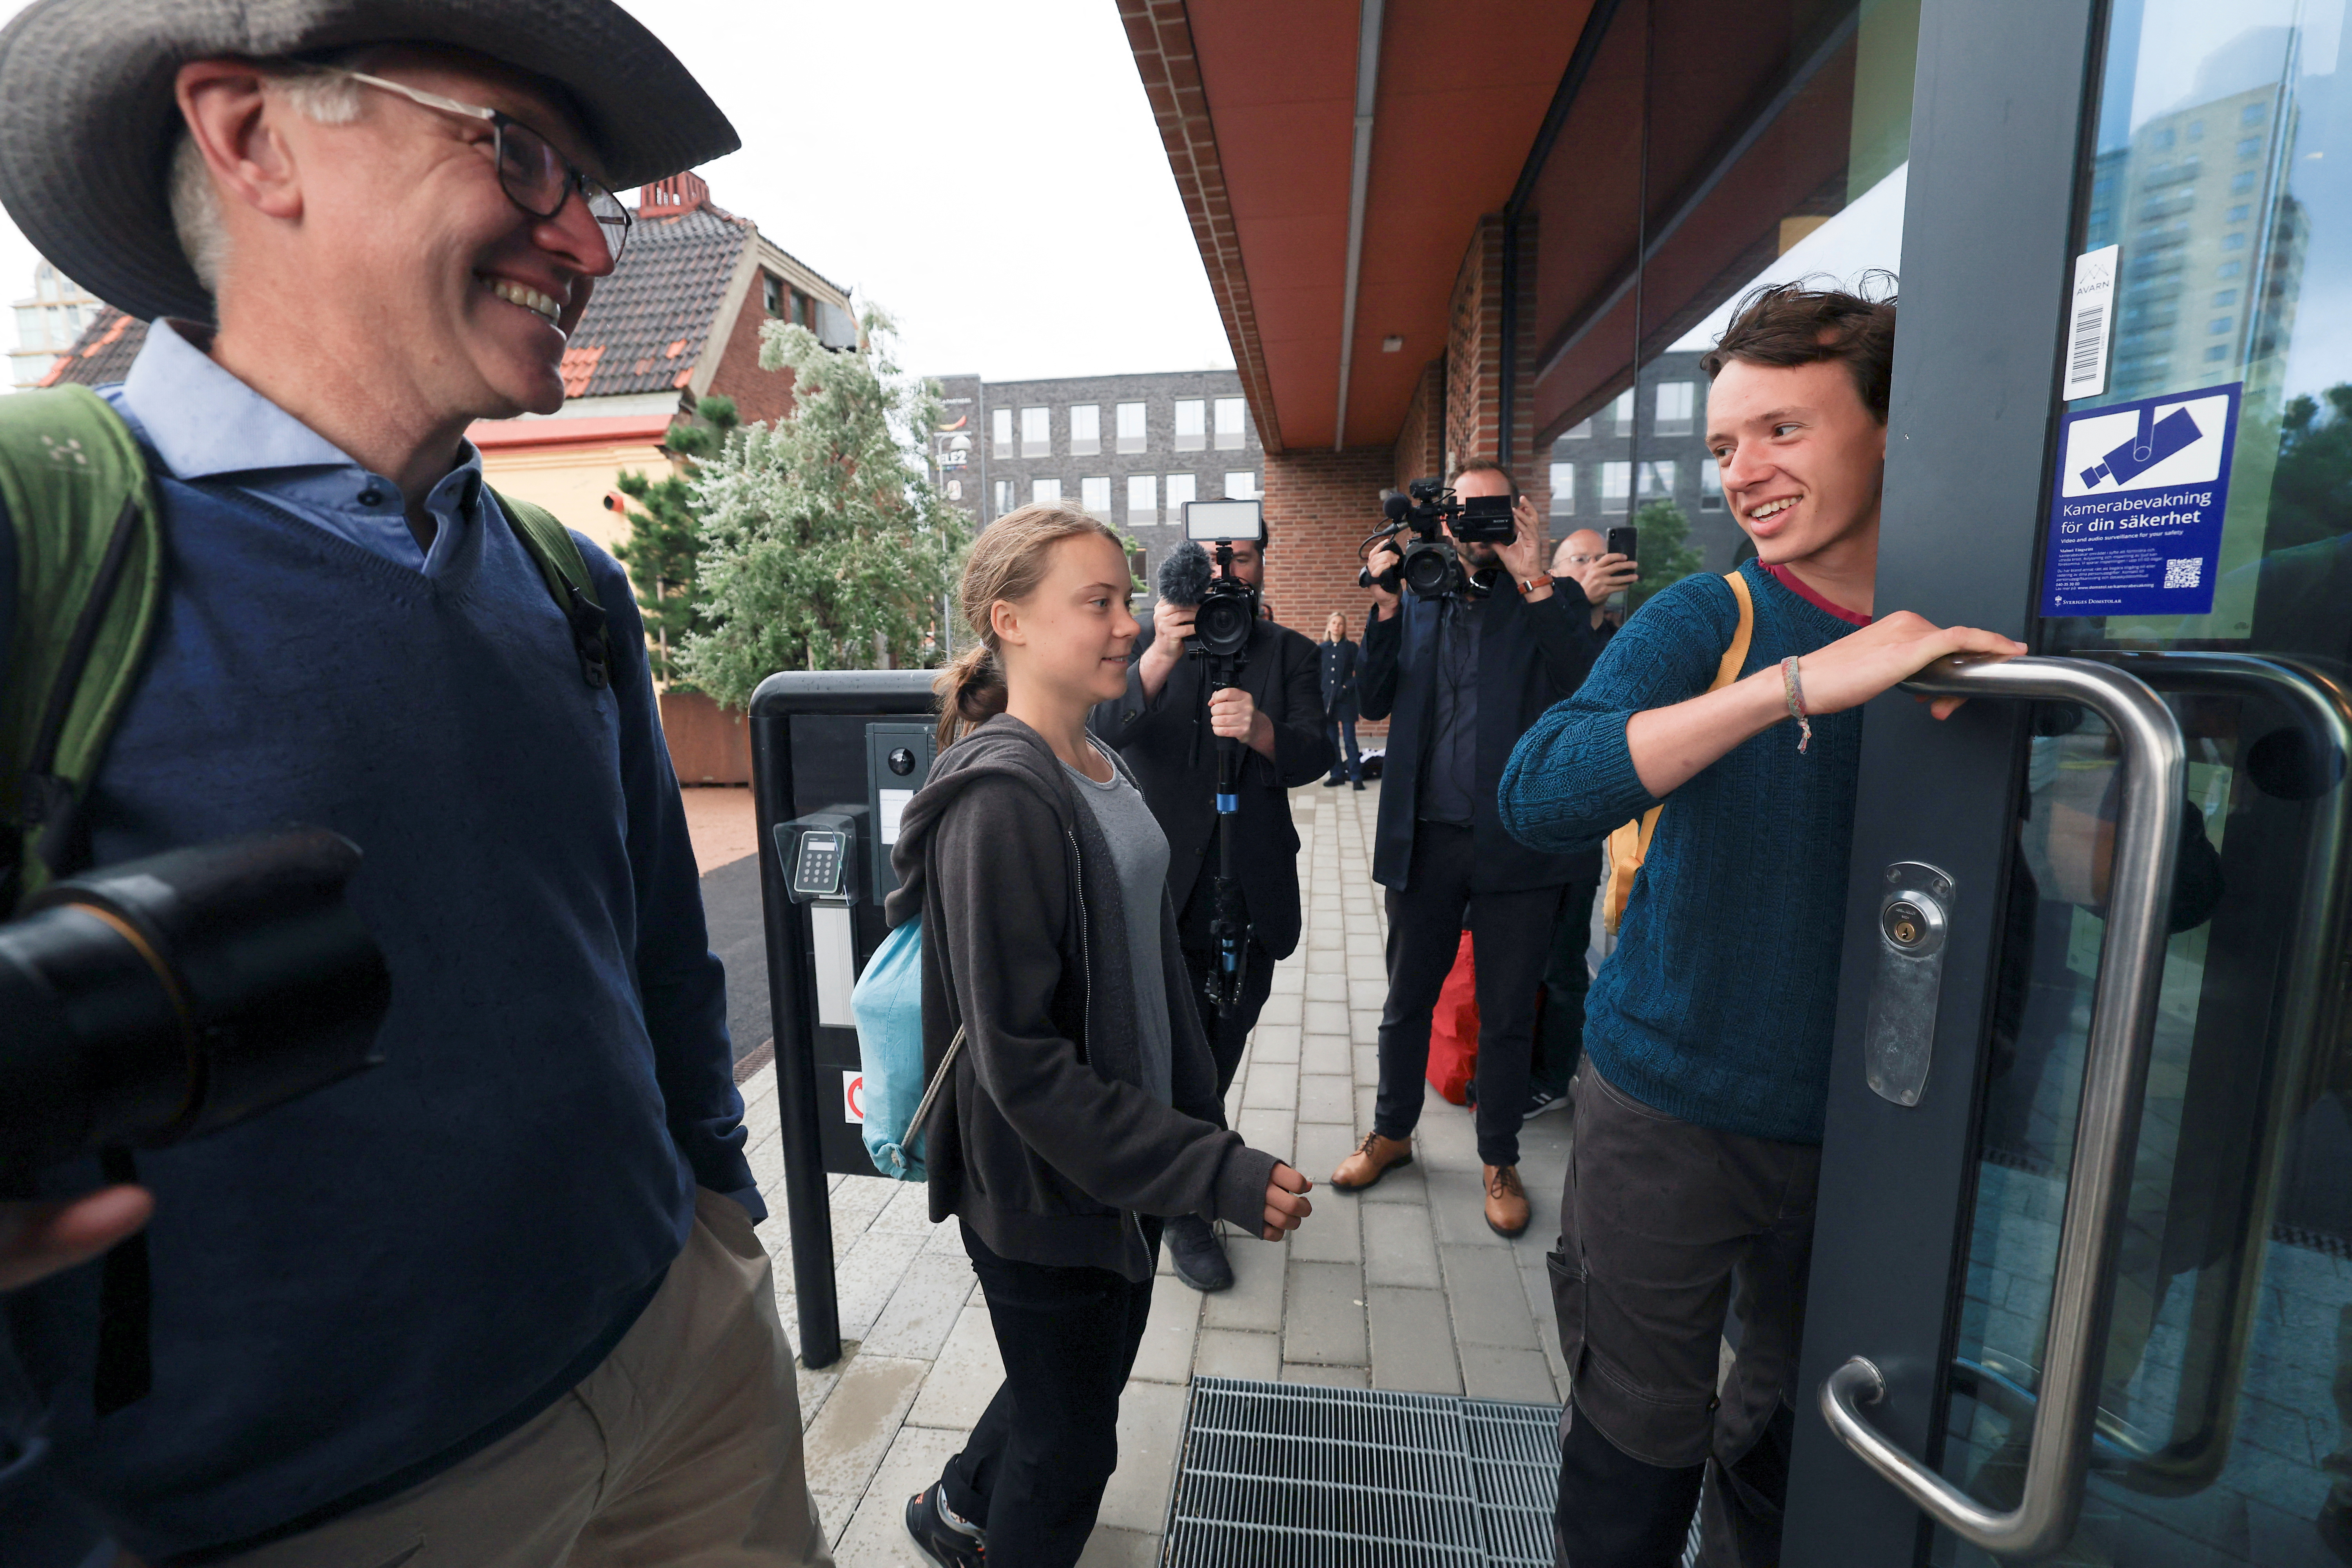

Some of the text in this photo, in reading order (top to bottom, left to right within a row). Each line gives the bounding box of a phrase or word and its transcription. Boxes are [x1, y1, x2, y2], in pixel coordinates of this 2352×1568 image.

[2076, 280, 2109, 296] AVARN
[2063, 492, 2212, 517] Kamerabevakning
[2061, 510, 2201, 534] för din säkerhet
